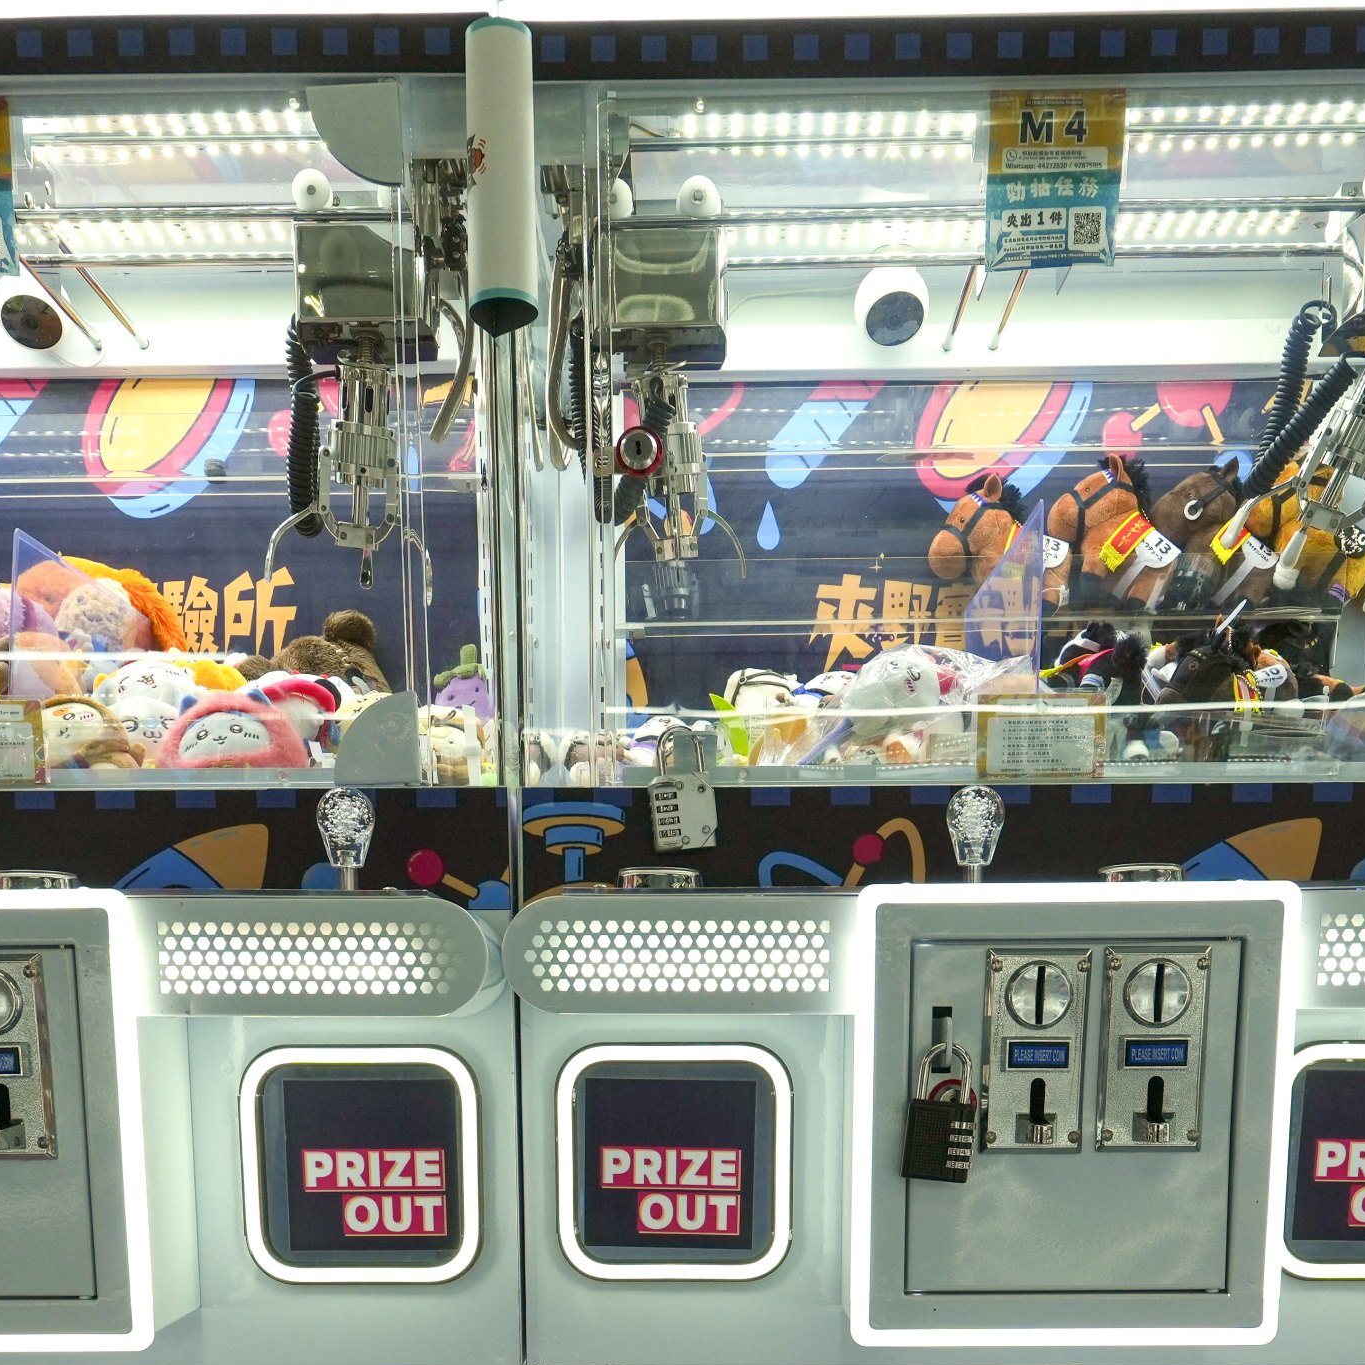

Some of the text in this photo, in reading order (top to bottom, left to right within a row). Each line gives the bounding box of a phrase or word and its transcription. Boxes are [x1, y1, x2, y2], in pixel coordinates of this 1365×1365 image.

[1005, 162, 1036, 170] Whatsapp:
[1014, 1050, 1065, 1062] PLEASE INSERT COIN
[1131, 1048, 1184, 1061] PLEASE INSERT COIN
[305, 1151, 441, 1188] PRIZE
[604, 1149, 737, 1187] PRIZE
[346, 1196, 442, 1233] OUT
[641, 1194, 737, 1231] OUT
